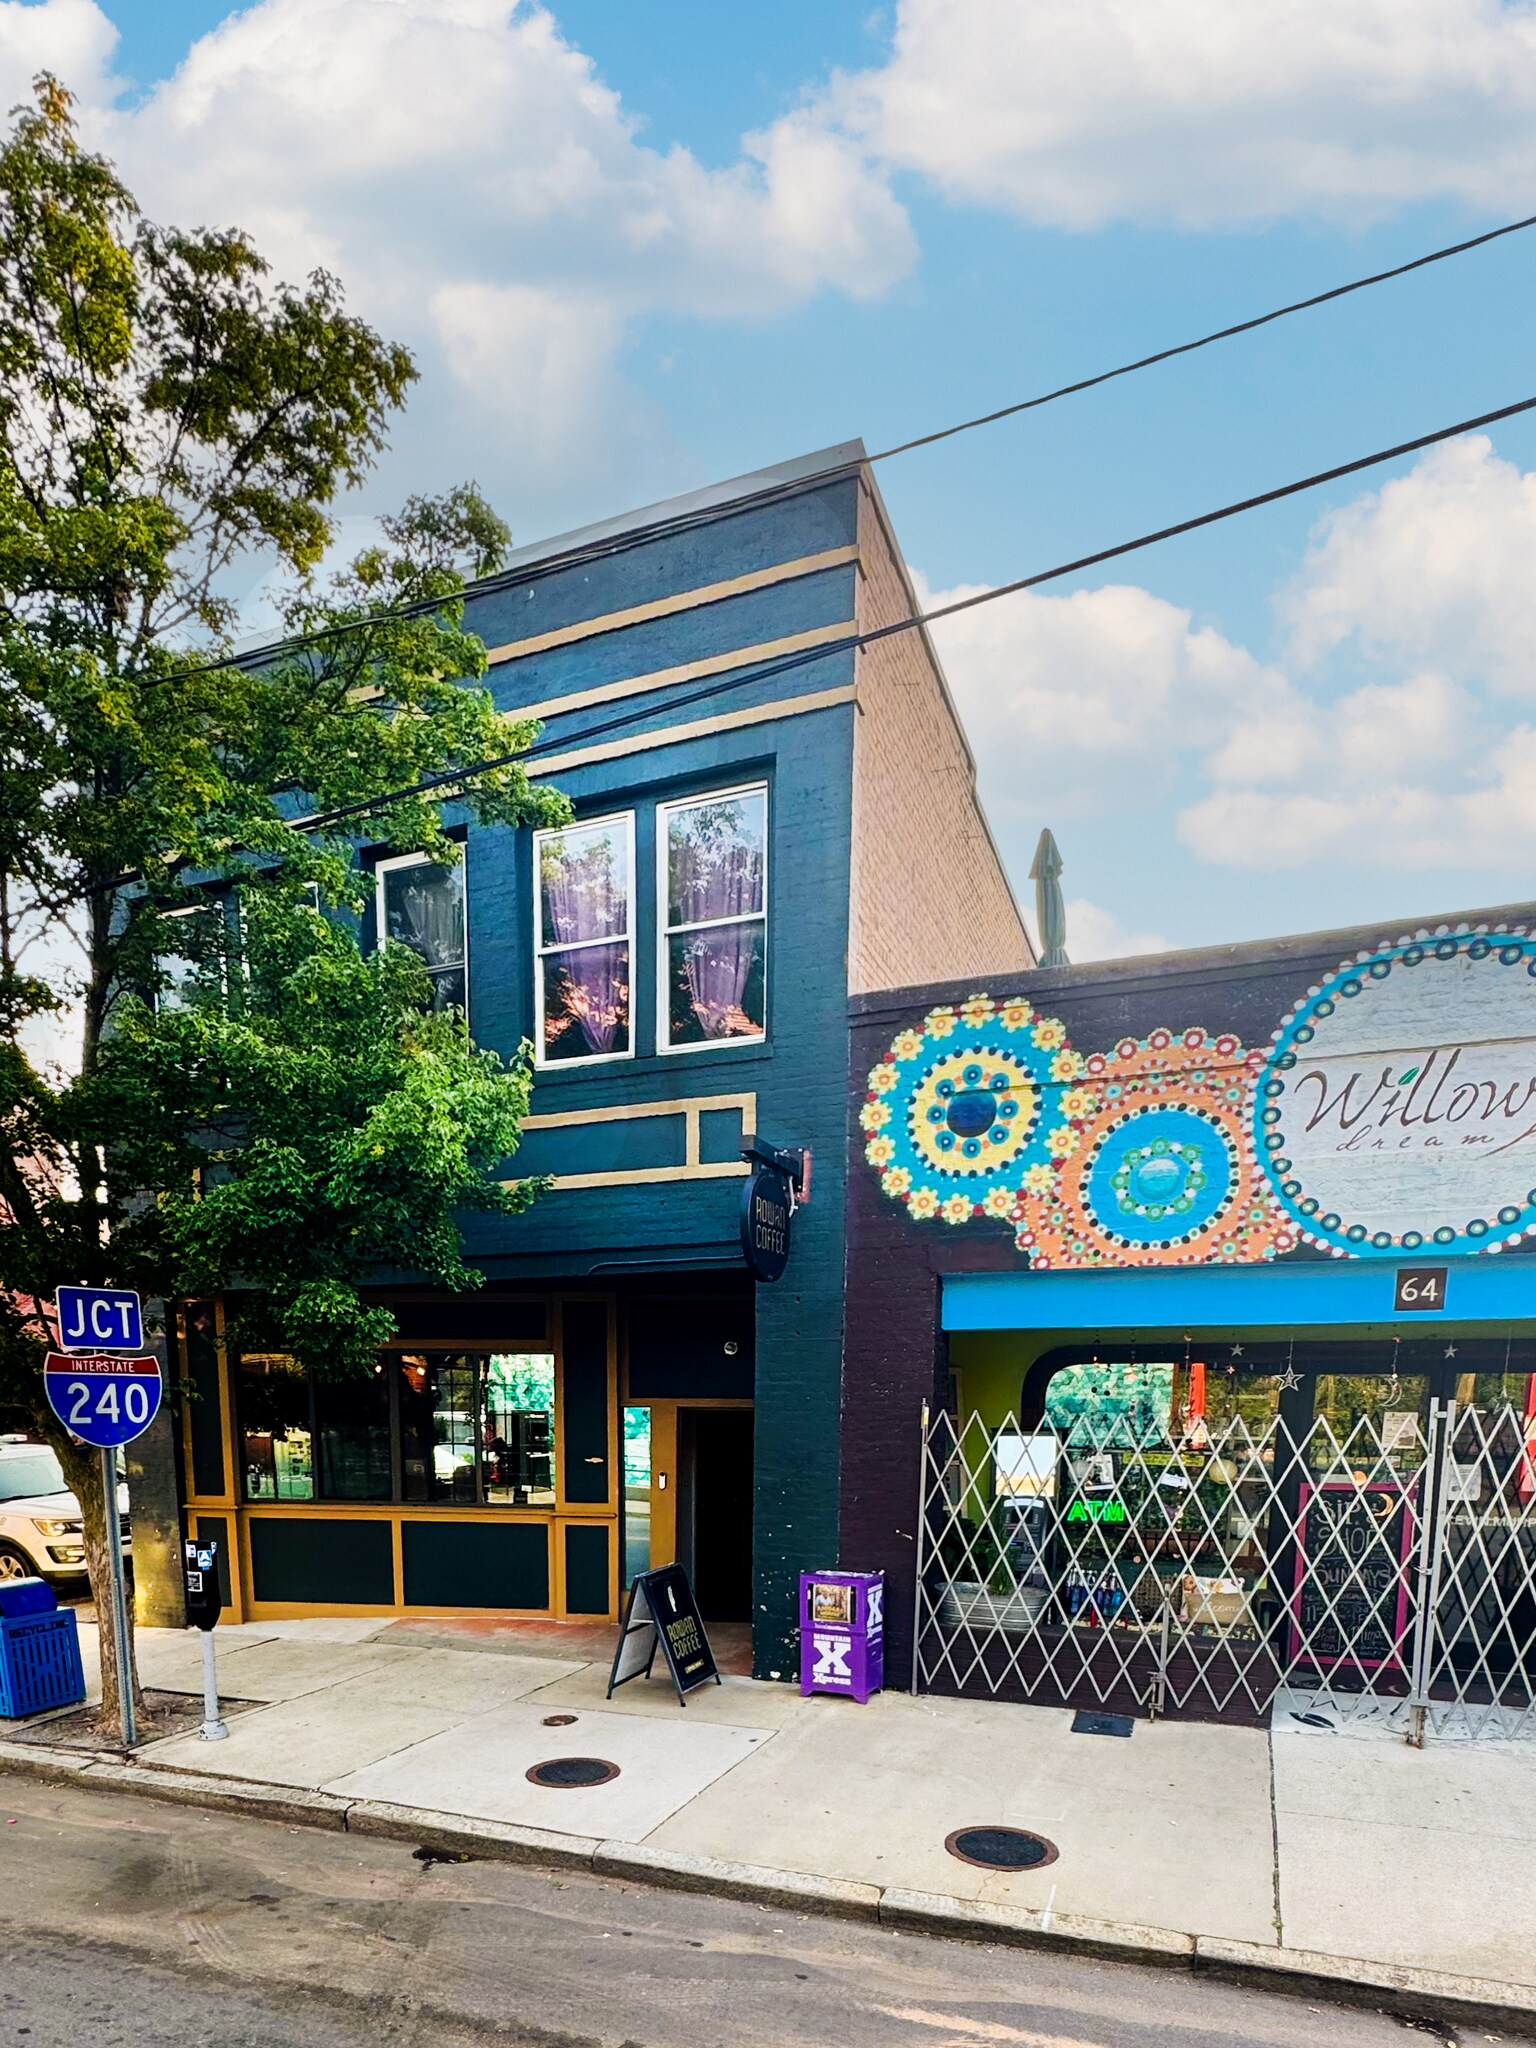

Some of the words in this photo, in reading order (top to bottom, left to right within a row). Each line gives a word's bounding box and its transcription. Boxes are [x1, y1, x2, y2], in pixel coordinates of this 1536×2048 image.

[1336, 1124, 1495, 1151] dream
[755, 1195, 786, 1230] ROWAN
[755, 1224, 786, 1255] COFFEE
[1400, 1277, 1439, 1302] 64
[67, 1299, 134, 1339] JCT
[71, 1359, 136, 1373] INTERSTATE
[67, 1381, 149, 1424] 240
[1067, 1500, 1125, 1522] ATM
[666, 1615, 697, 1643] ROWAN
[672, 1632, 702, 1660] COFFEE
[812, 1640, 852, 1676] X
[812, 1672, 852, 1685] Xpress
